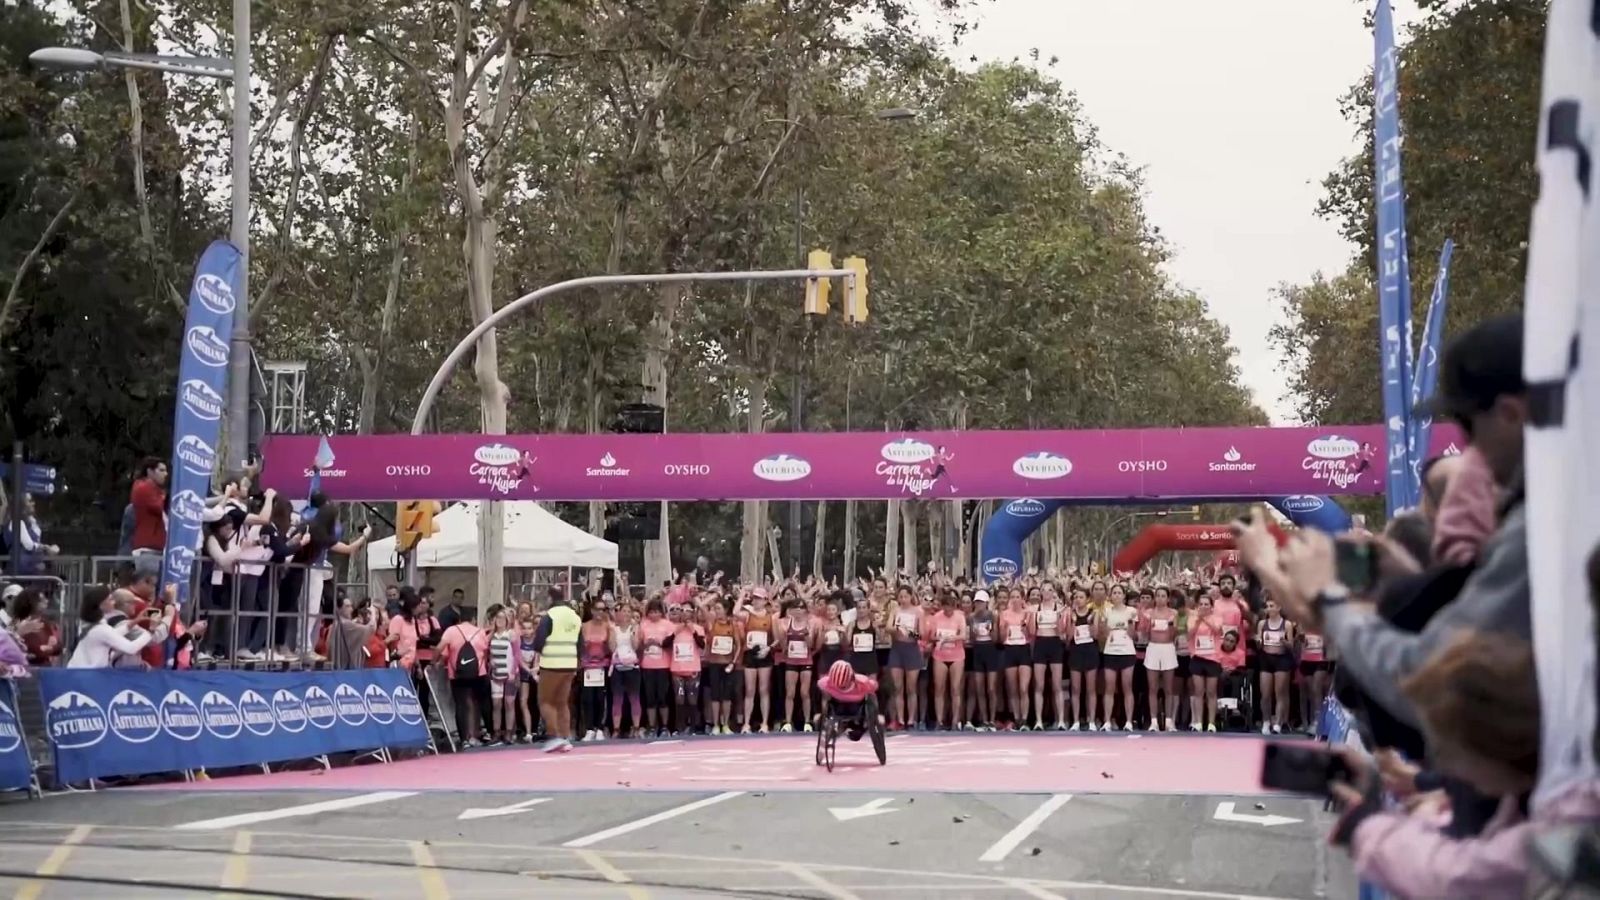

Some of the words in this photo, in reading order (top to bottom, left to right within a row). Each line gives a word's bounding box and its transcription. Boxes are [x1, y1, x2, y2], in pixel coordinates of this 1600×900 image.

[470, 462, 508, 476] Carrera
[664, 464, 710, 476] OYSHO
[875, 461, 921, 475] Carrera
[1019, 462, 1068, 473] ASTURIANA
[1118, 460, 1168, 472] OYSHO
[1208, 462, 1257, 471] Santander
[1302, 456, 1346, 470] Carrera
[303, 467, 347, 477] Satander
[386, 465, 431, 476] OYSHO
[586, 467, 631, 476] Santander
[490, 474, 522, 495] Mujer
[901, 473, 938, 495] Mujer
[1327, 468, 1363, 489] Mujer
[113, 708, 158, 729] ASTURIANA
[53, 717, 104, 736] STURIANA
